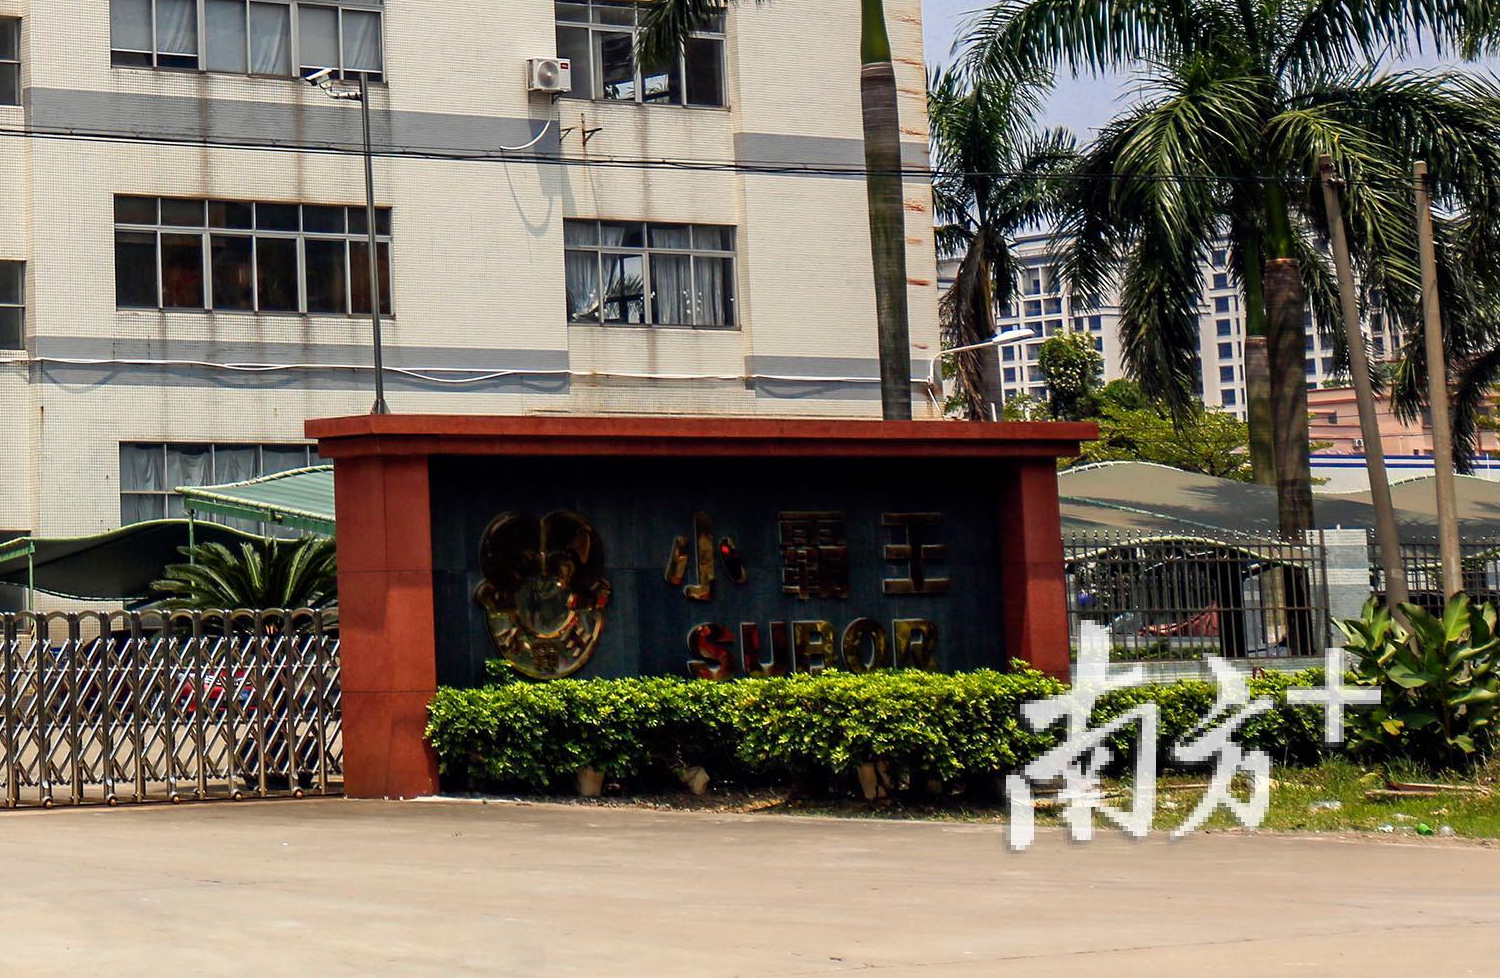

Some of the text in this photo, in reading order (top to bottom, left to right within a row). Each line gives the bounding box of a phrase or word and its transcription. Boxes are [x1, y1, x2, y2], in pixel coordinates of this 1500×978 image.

[664, 511, 949, 601] 小霸王
[686, 618, 939, 680] SUBOR
